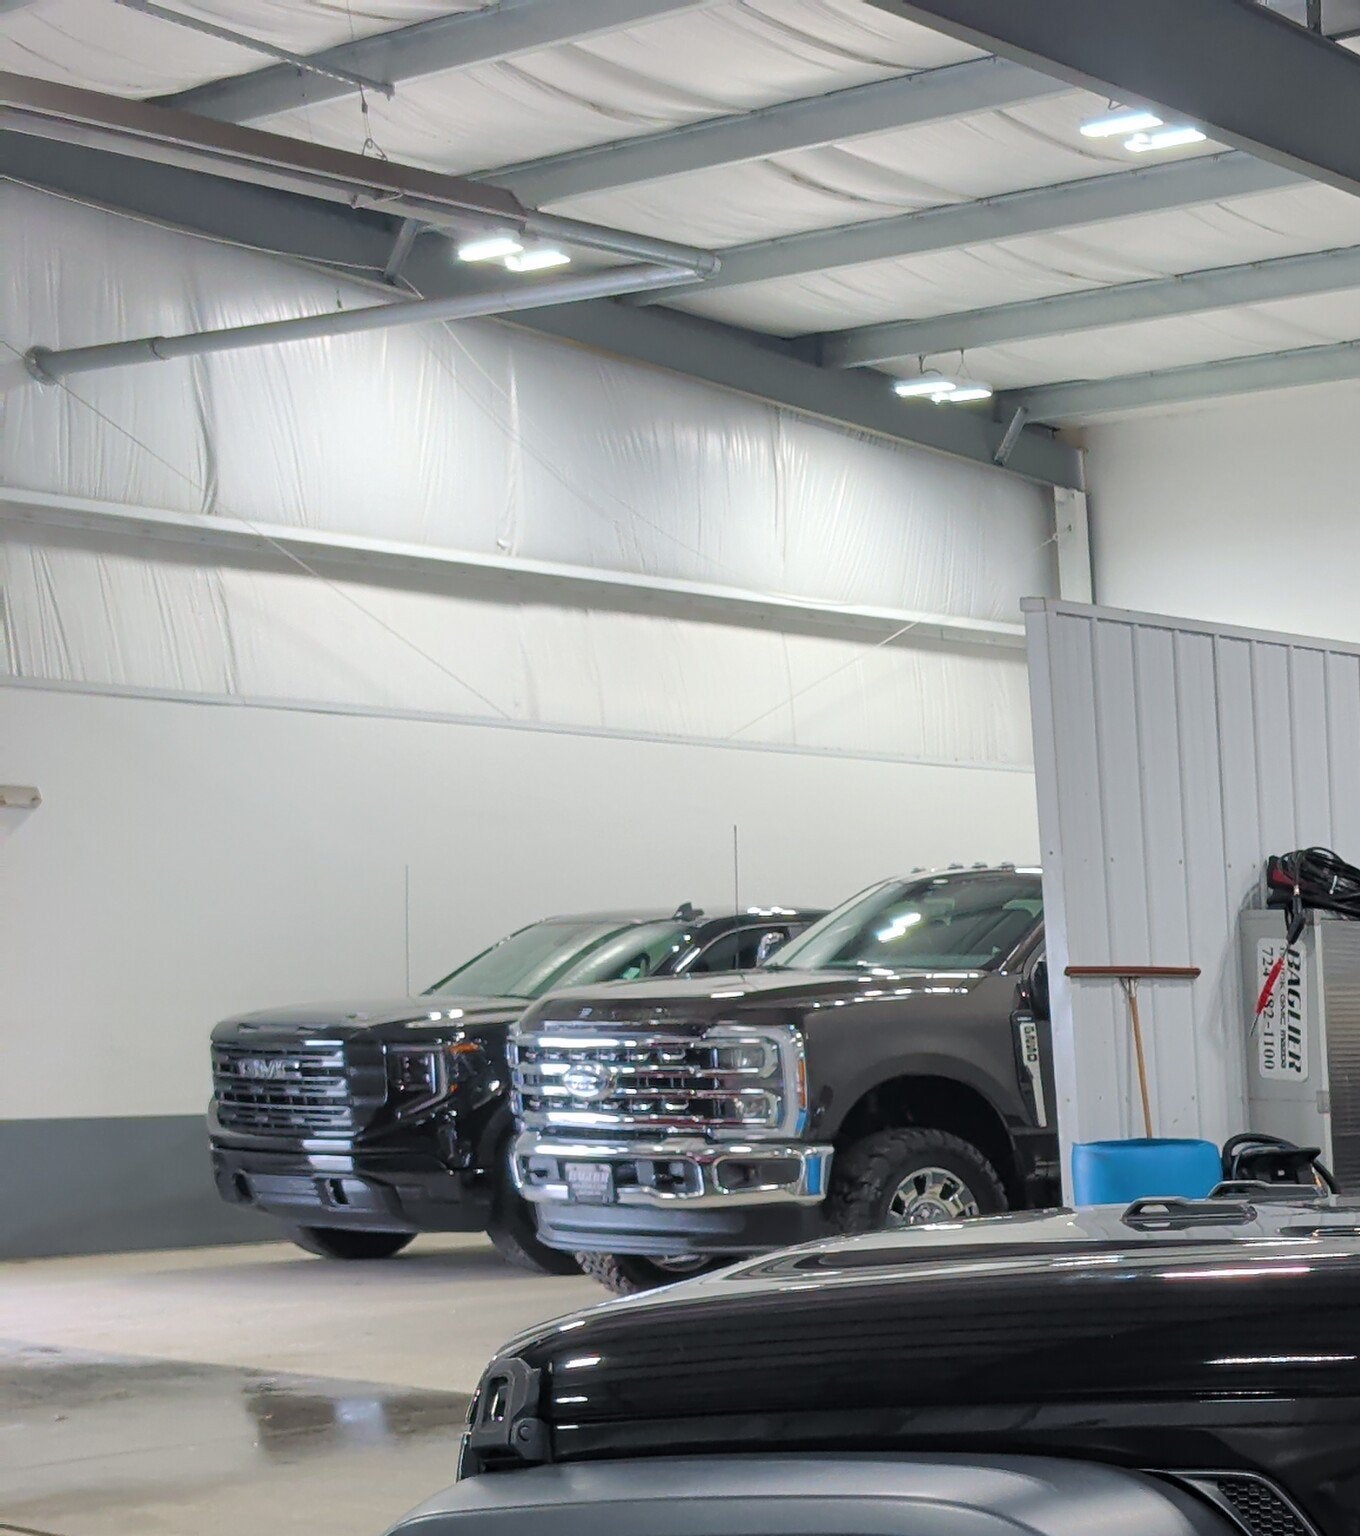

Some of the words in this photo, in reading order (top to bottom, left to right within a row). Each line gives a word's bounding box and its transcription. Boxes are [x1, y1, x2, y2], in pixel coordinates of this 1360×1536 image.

[1262, 946, 1274, 978] 724
[1263, 992, 1275, 1070] 82-1100
[1287, 947, 1302, 1074] BAGLIER
